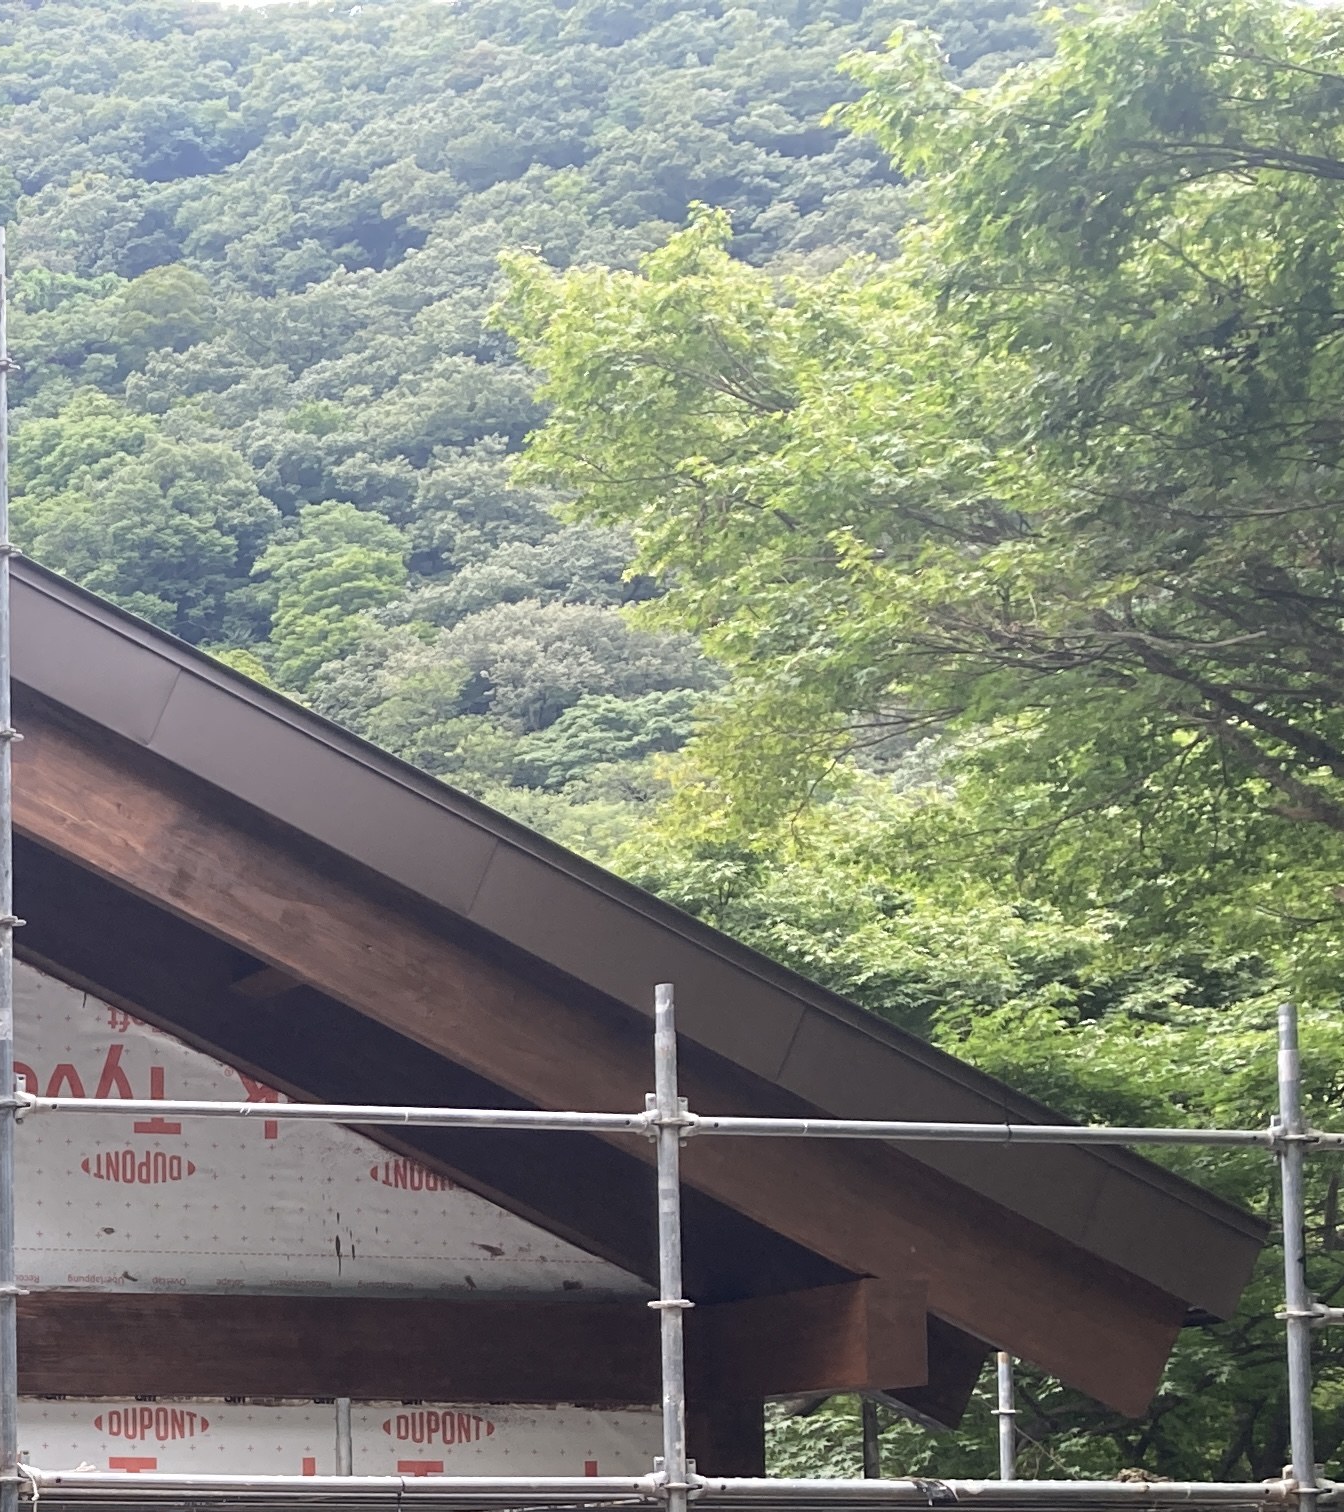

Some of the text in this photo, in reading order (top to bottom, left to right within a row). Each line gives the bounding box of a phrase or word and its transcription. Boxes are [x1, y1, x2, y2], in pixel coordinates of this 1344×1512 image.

[92, 1150, 181, 1184] DUPONT
[109, 1406, 197, 1441] DUPONT
[397, 1411, 483, 1445] DUPONT
